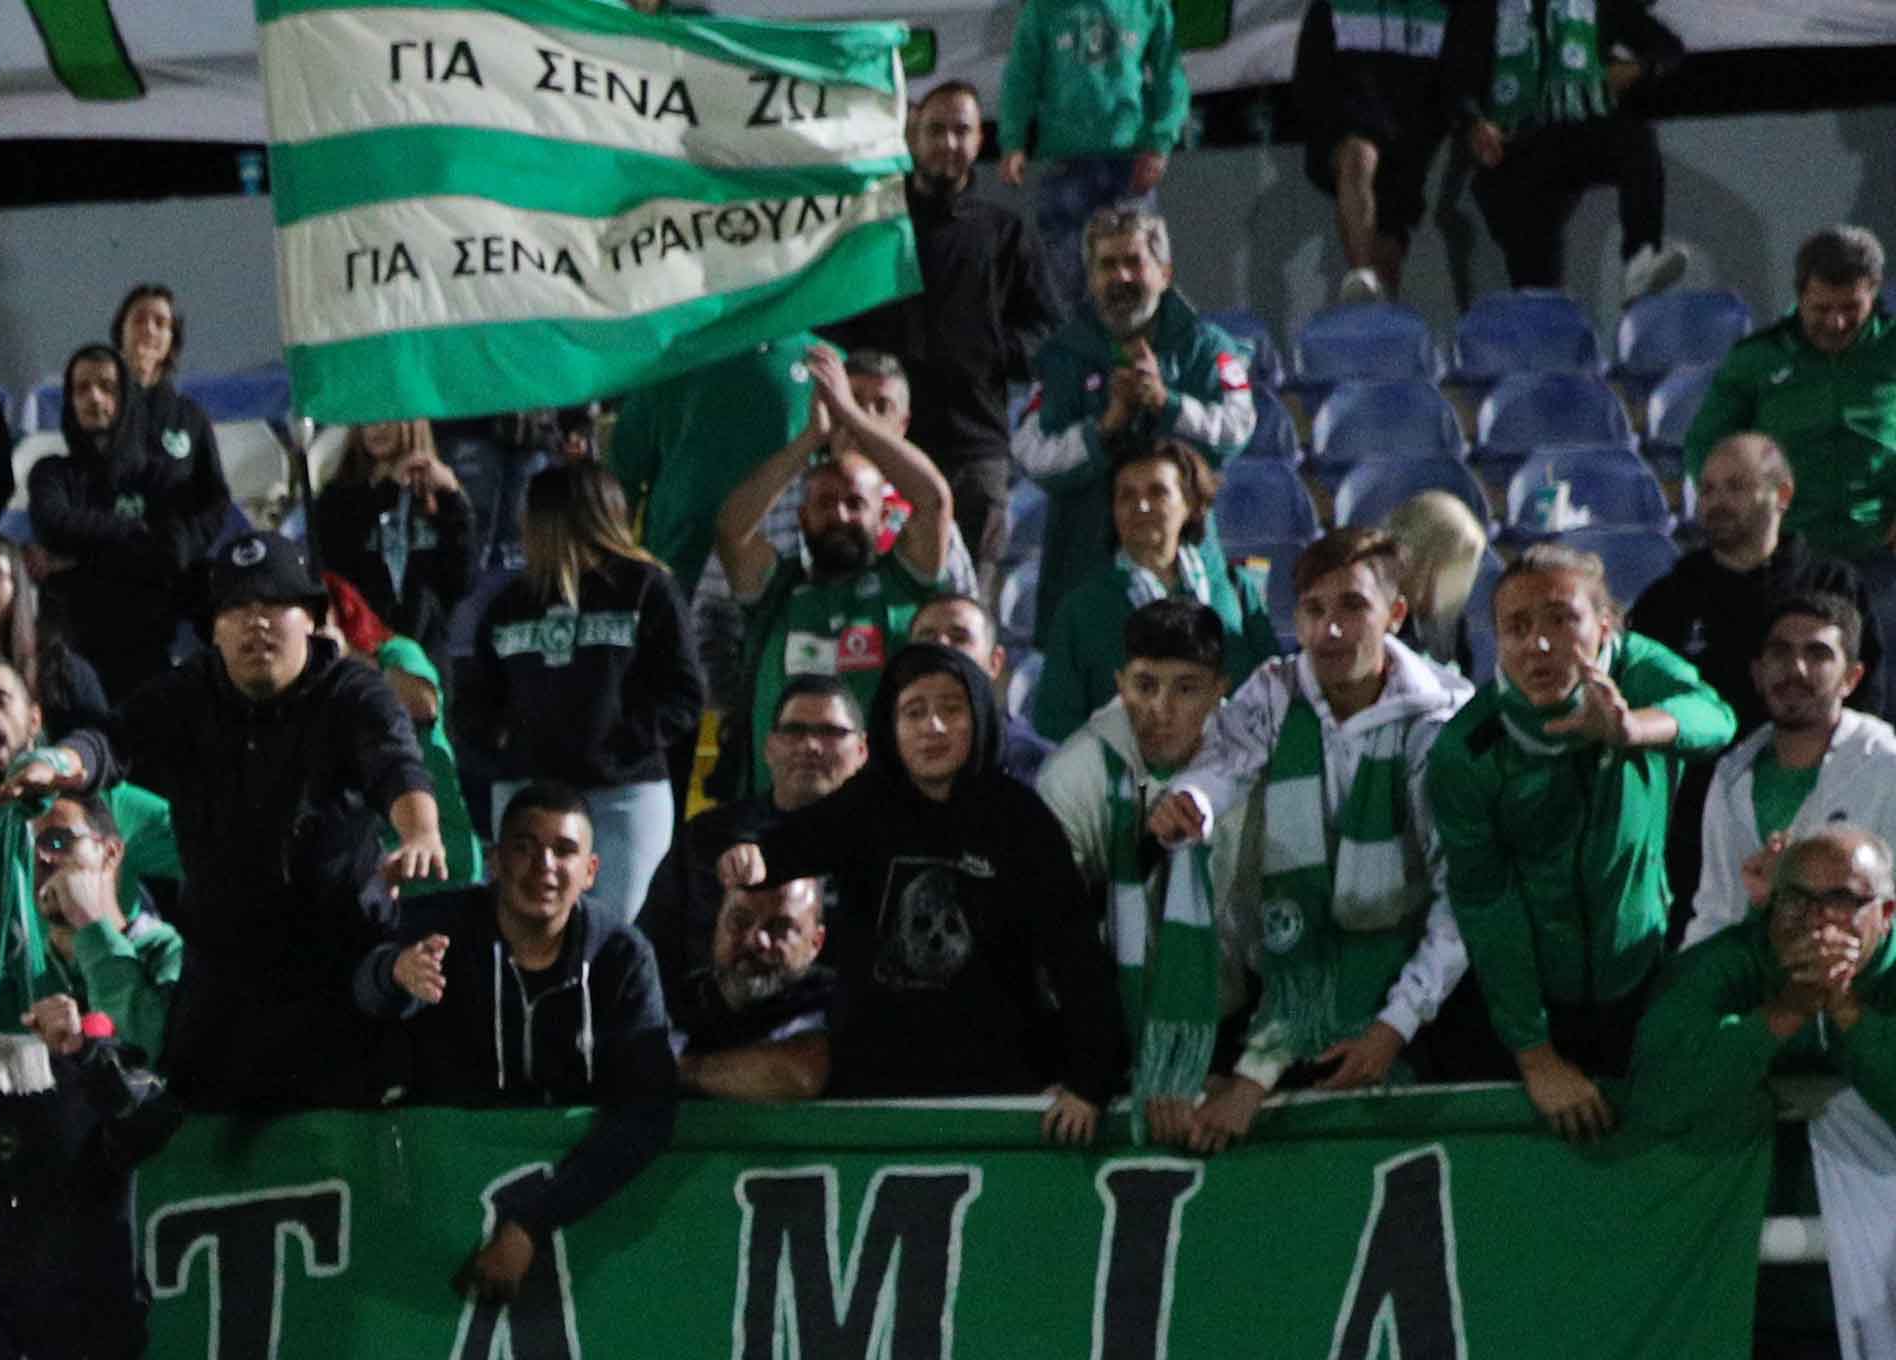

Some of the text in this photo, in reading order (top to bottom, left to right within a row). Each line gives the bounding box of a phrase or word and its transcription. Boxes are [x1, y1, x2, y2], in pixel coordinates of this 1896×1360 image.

[388, 39, 484, 88] ΓΙΑ
[535, 48, 699, 127] ΣΕΝΑ
[344, 238, 421, 291] ΓΙΑ
[451, 235, 585, 284] ΣΕΝΑ
